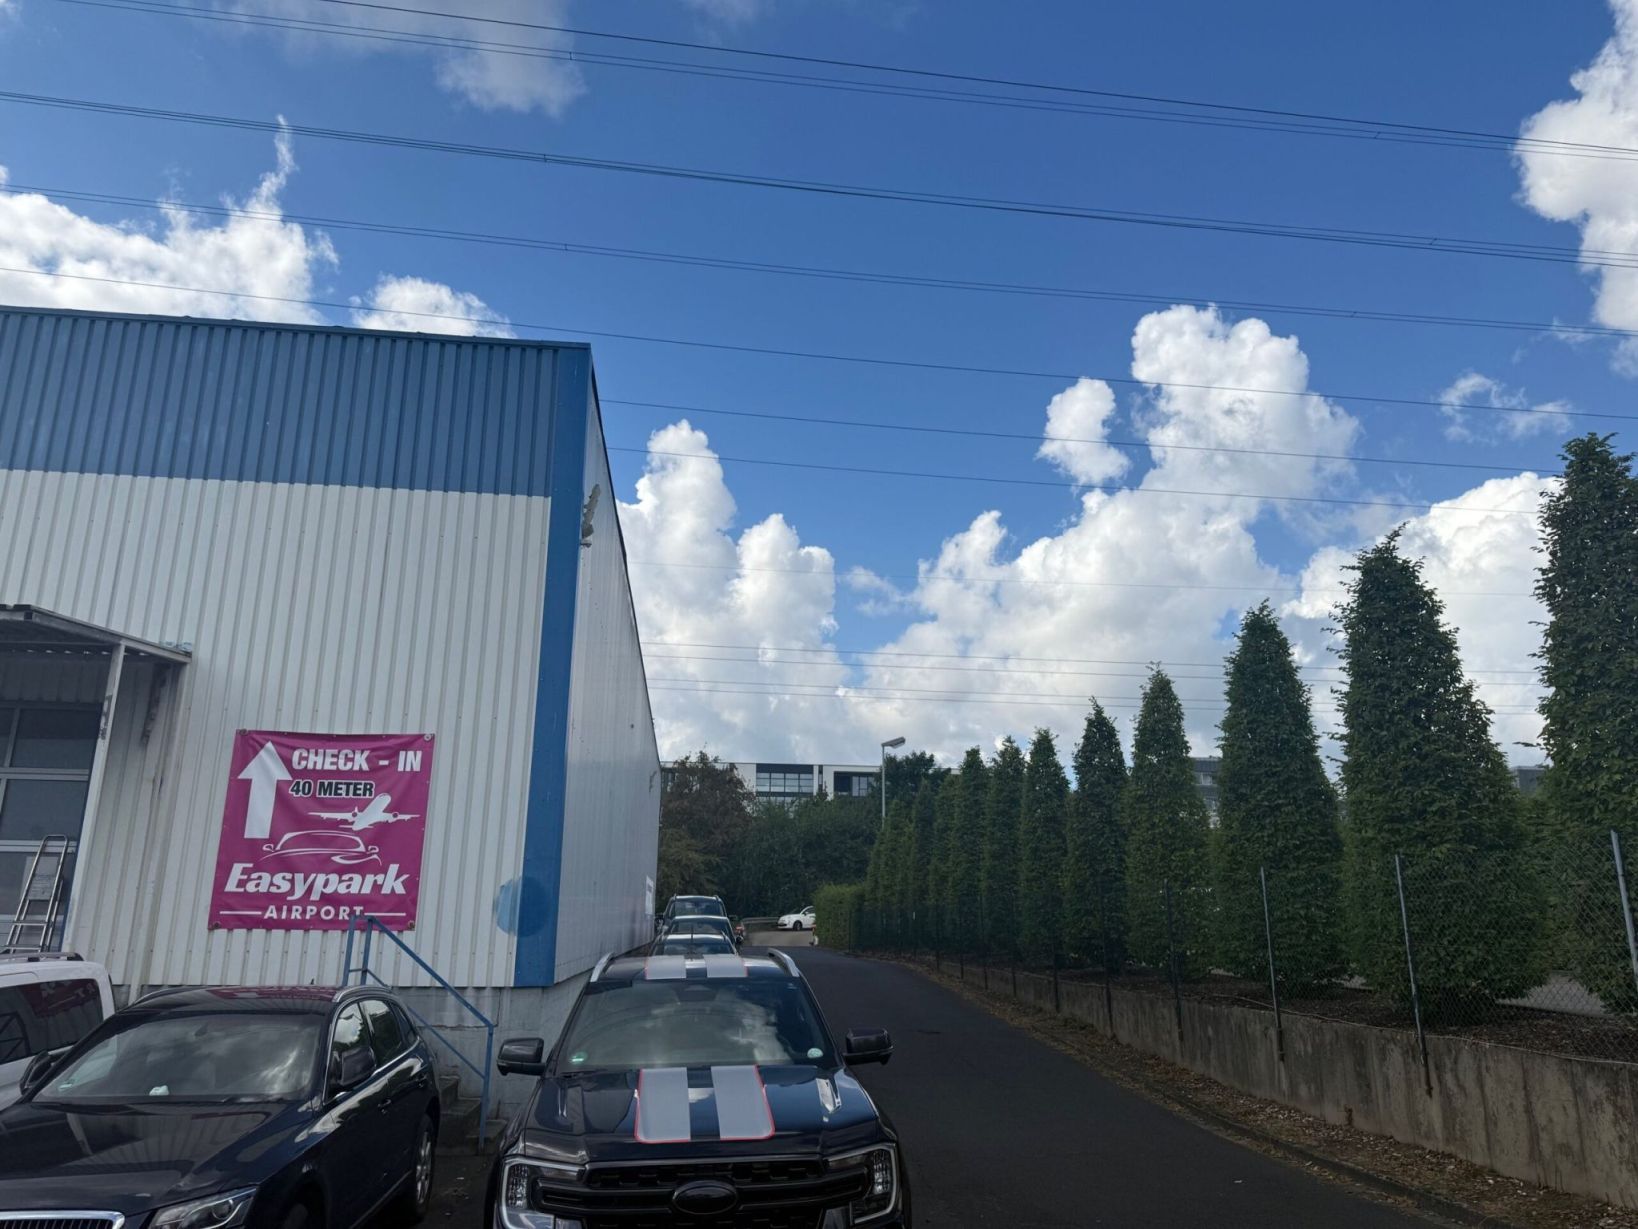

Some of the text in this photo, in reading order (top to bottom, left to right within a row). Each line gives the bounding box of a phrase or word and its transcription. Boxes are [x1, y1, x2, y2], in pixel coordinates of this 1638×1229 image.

[291, 748, 370, 771] CHECK
[397, 750, 423, 772] IN
[289, 779, 375, 798] 40 METER
[224, 862, 410, 901] Easypark
